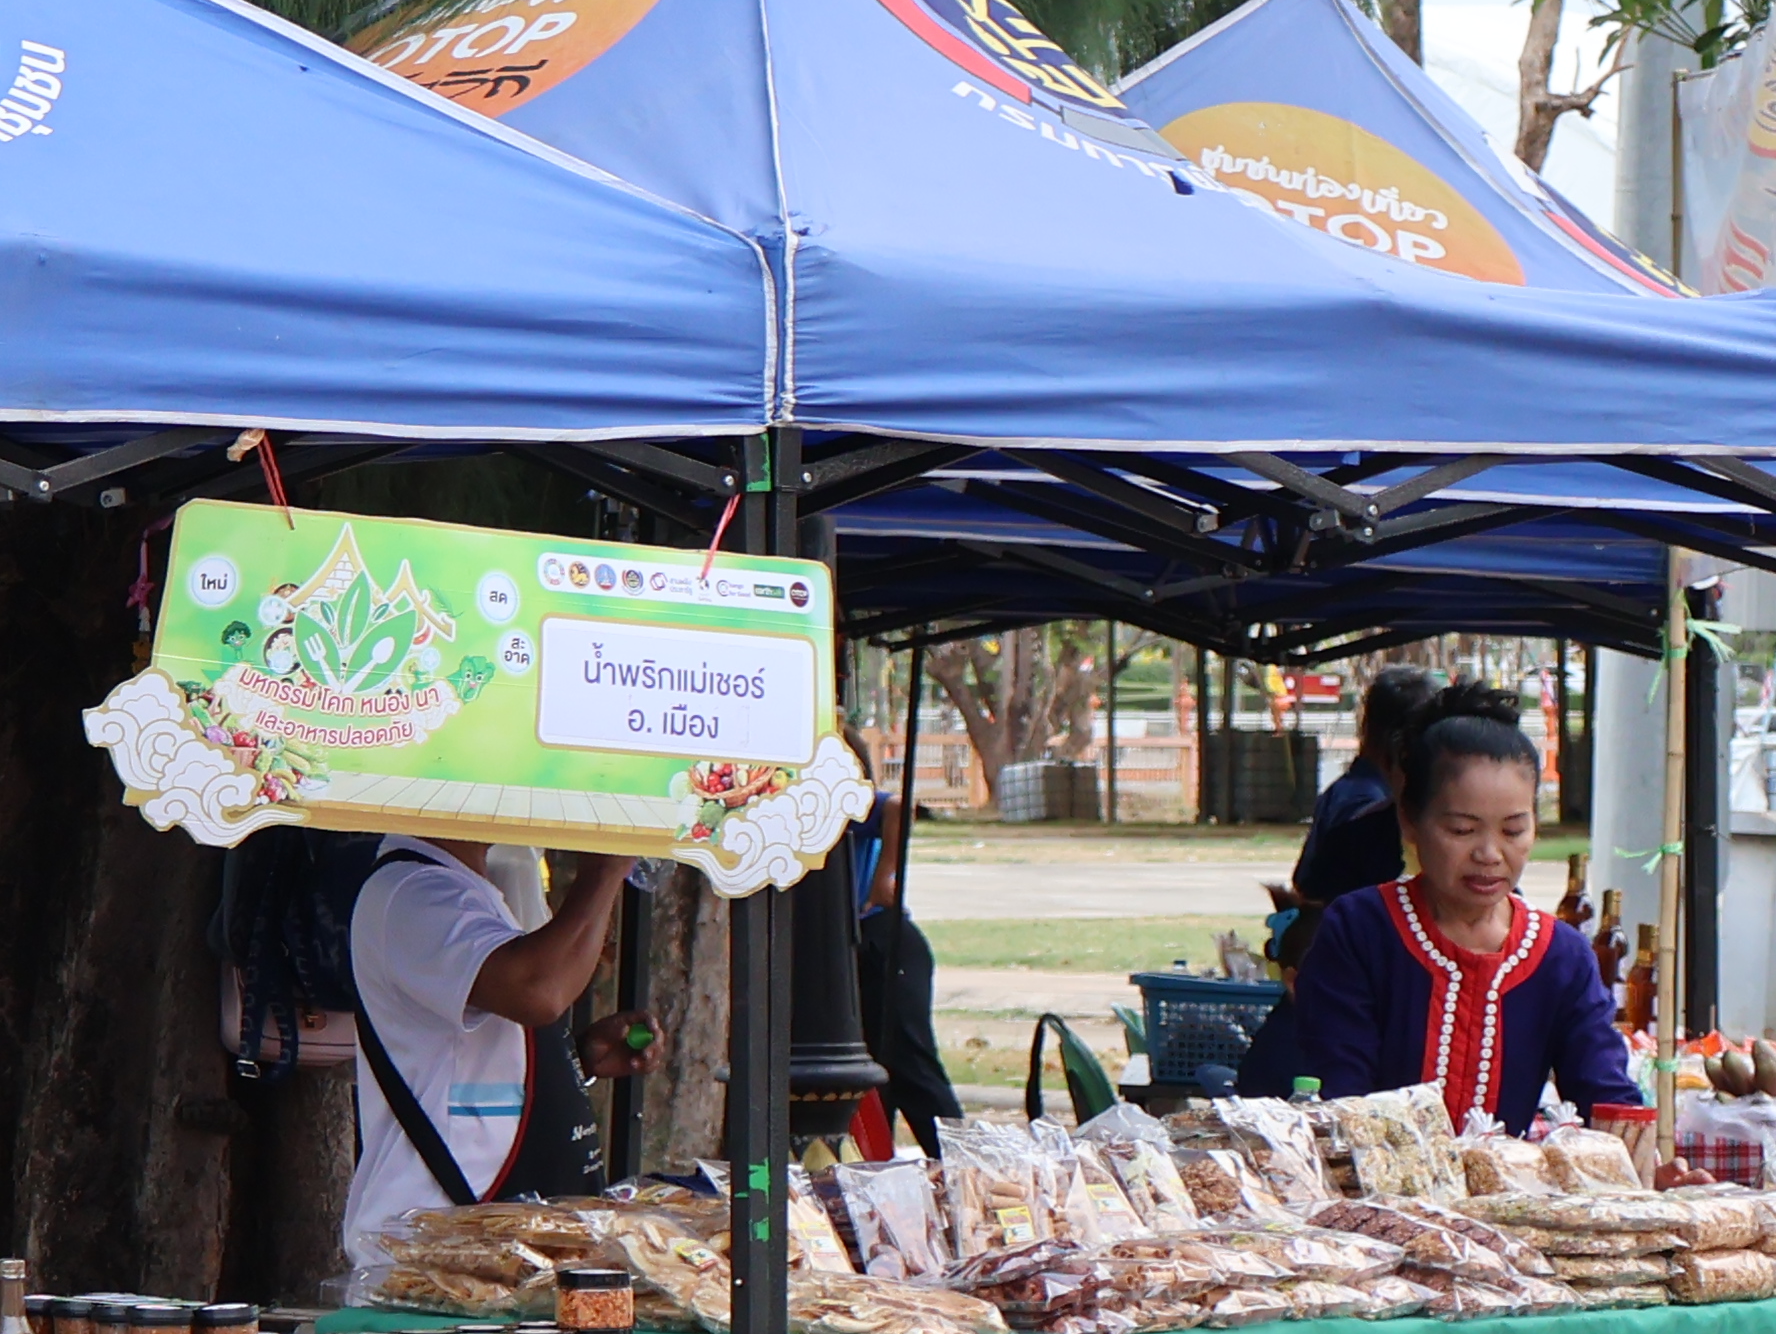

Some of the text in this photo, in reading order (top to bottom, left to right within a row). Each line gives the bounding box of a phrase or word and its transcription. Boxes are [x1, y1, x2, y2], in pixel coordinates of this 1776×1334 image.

[200, 573, 229, 591] ใหม่
[489, 590, 508, 605] สด
[583, 642, 766, 699] น้ำพริกแม่เชอร์
[238, 667, 441, 714] มหกรรม โคก หนอง นา
[254, 710, 414, 745] และอาหารปลอดภัย
[628, 703, 720, 739] อ. เมือง
